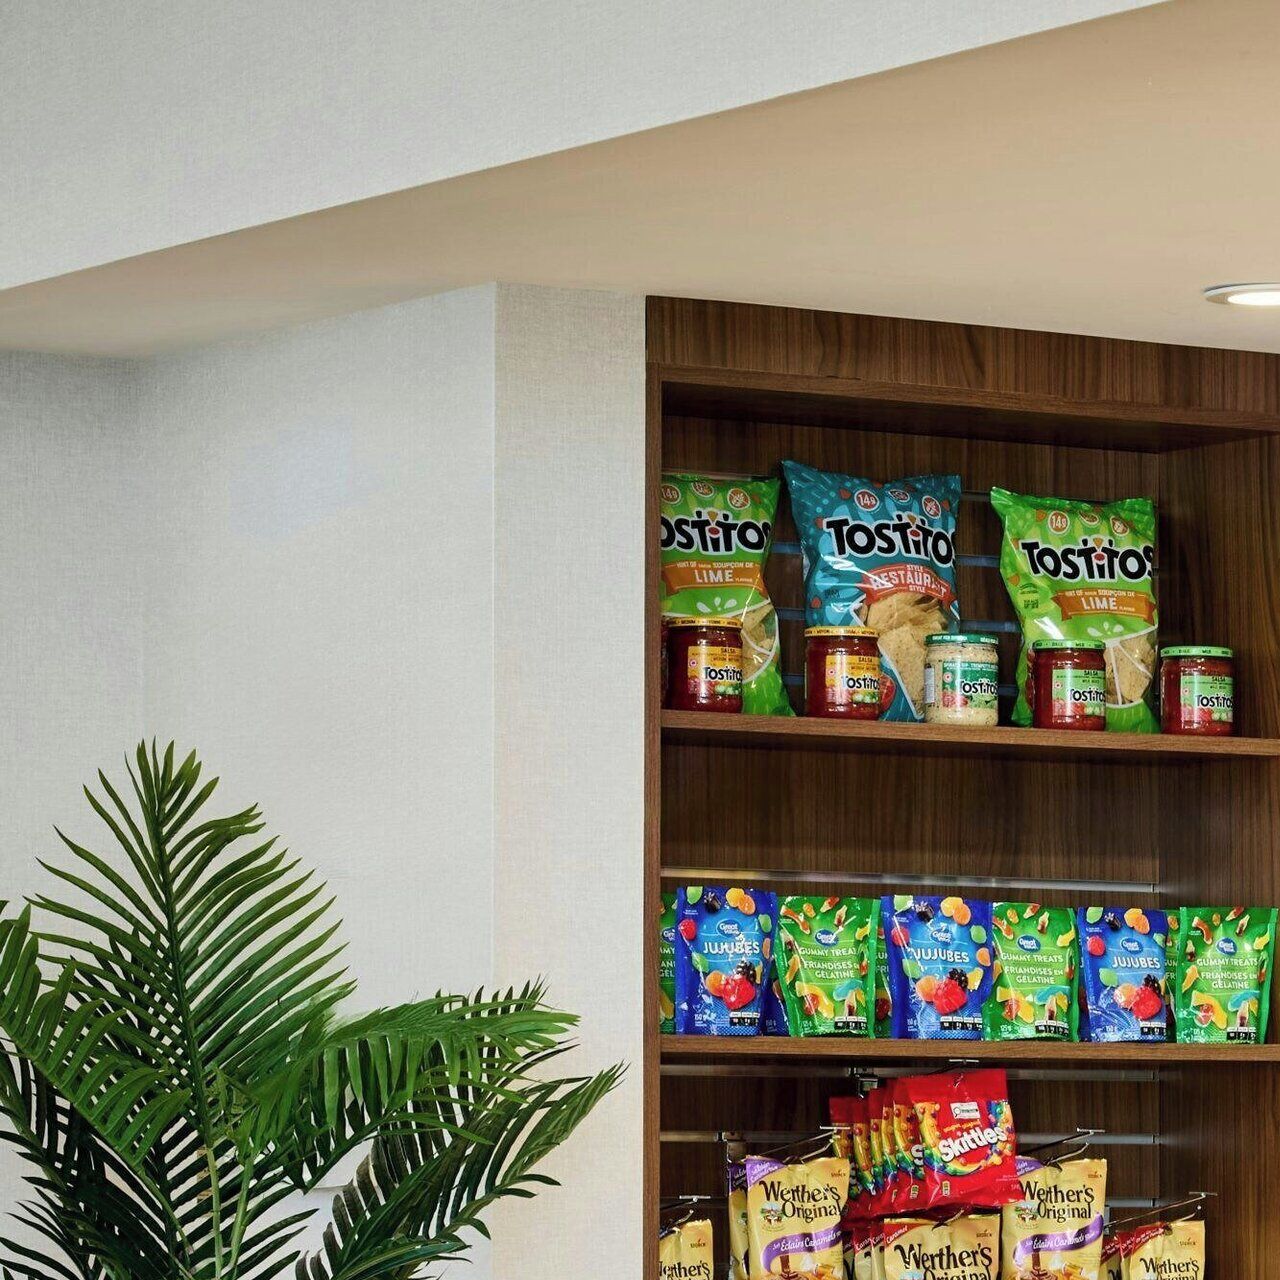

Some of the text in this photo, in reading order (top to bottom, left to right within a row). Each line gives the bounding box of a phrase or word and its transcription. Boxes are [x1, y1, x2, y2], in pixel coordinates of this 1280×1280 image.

[695, 570, 733, 583] LIME
[1081, 598, 1118, 610] LIME
[703, 940, 760, 955] JUJUBES
[800, 947, 829, 957] GUMMY
[803, 960, 853, 971] FRIANDISES
[1001, 953, 1064, 964] GUMMY TREATS
[1111, 956, 1161, 970] JUJUBES
[1196, 958, 1258, 968] GUMMY TREATS
[1004, 965, 1053, 976] FRIANDISES
[1201, 971, 1249, 981] FRIANDISES
[938, 1126, 1007, 1163] Skittles
[758, 1179, 841, 1203] Werther's
[1019, 1180, 1094, 1204] Werther's
[782, 1203, 841, 1224] Original
[1036, 1203, 1092, 1223] Original
[897, 1244, 992, 1270] Werther's
[1140, 1257, 1199, 1275] Werther's
